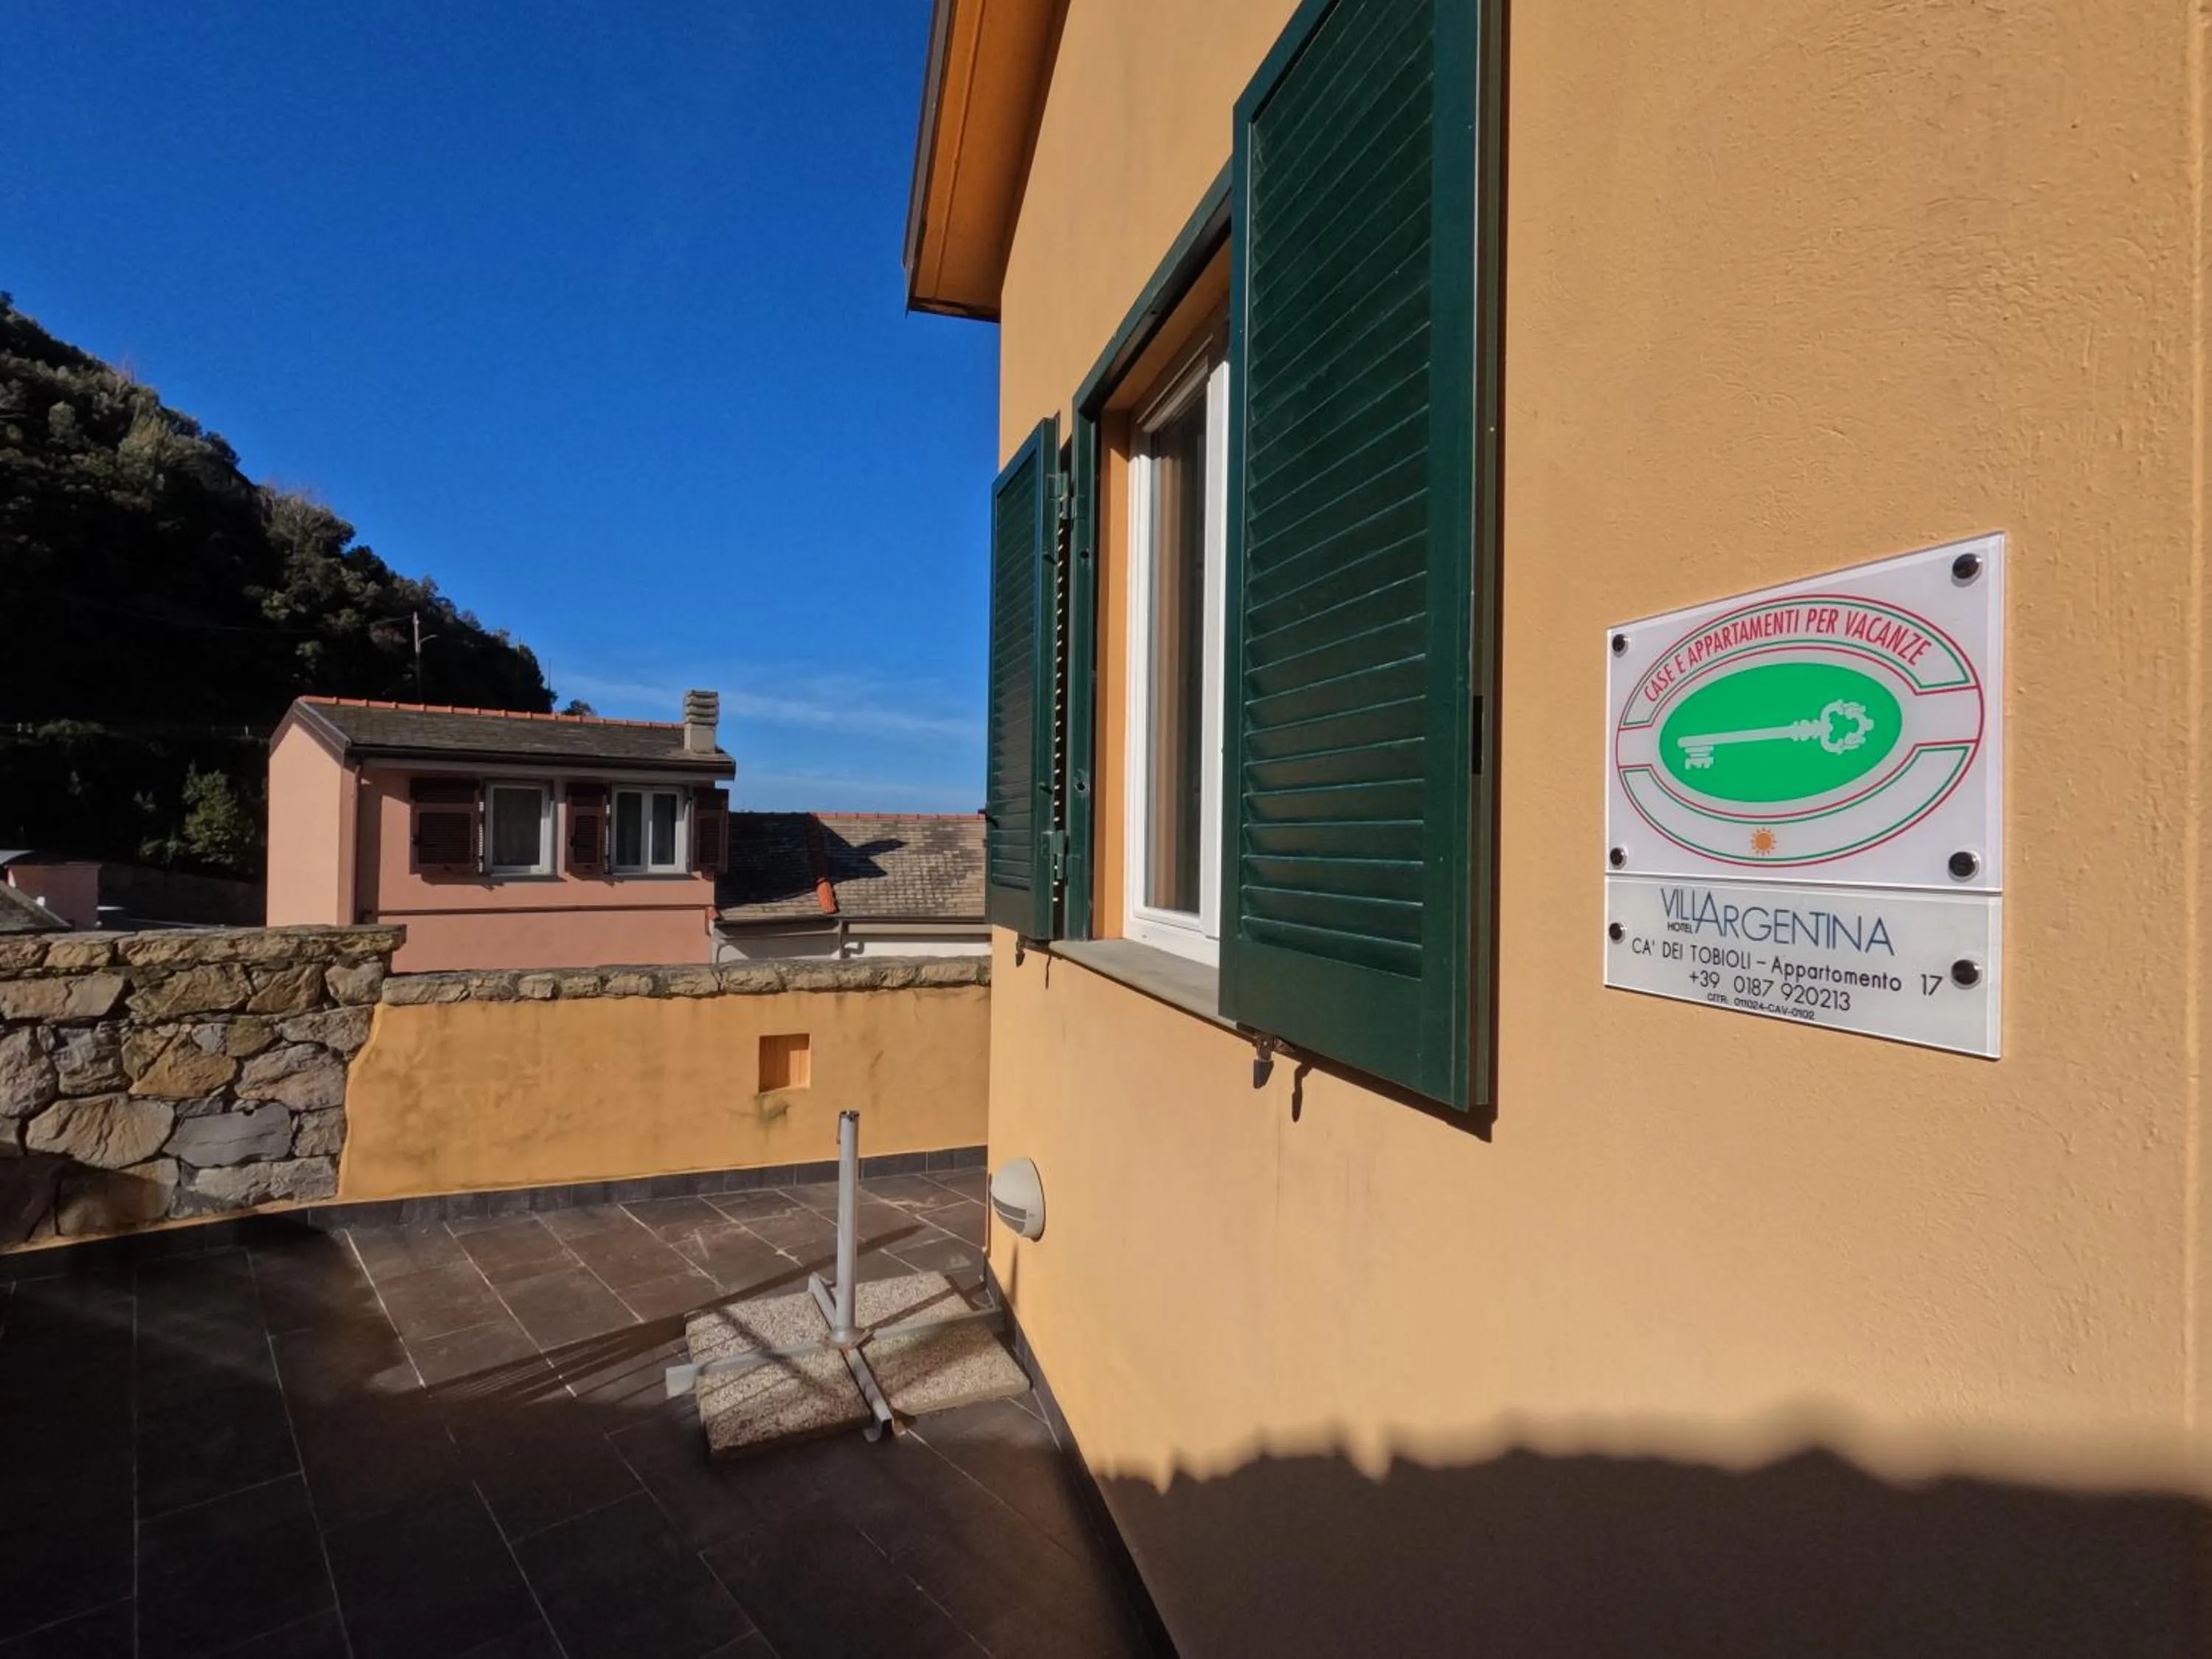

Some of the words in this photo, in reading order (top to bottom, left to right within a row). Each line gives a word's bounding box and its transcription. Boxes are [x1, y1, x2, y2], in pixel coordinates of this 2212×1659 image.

[1644, 667, 1676, 703] CASE
[1674, 653, 1687, 675] E
[1686, 609, 1799, 670] APPARTAMENTI
[1805, 608, 1839, 633] PER
[1844, 610, 1933, 667] VACANZE
[1667, 922, 1693, 934] HOTEL
[1632, 937, 1655, 956] CA'
[1662, 942, 1683, 959] DEI
[1690, 945, 1751, 970] TOBIOLI
[1920, 973, 1944, 996] 17
[1689, 970, 1721, 989] +39
[1733, 975, 1775, 997] 0187
[1781, 982, 1851, 1012] 920213
